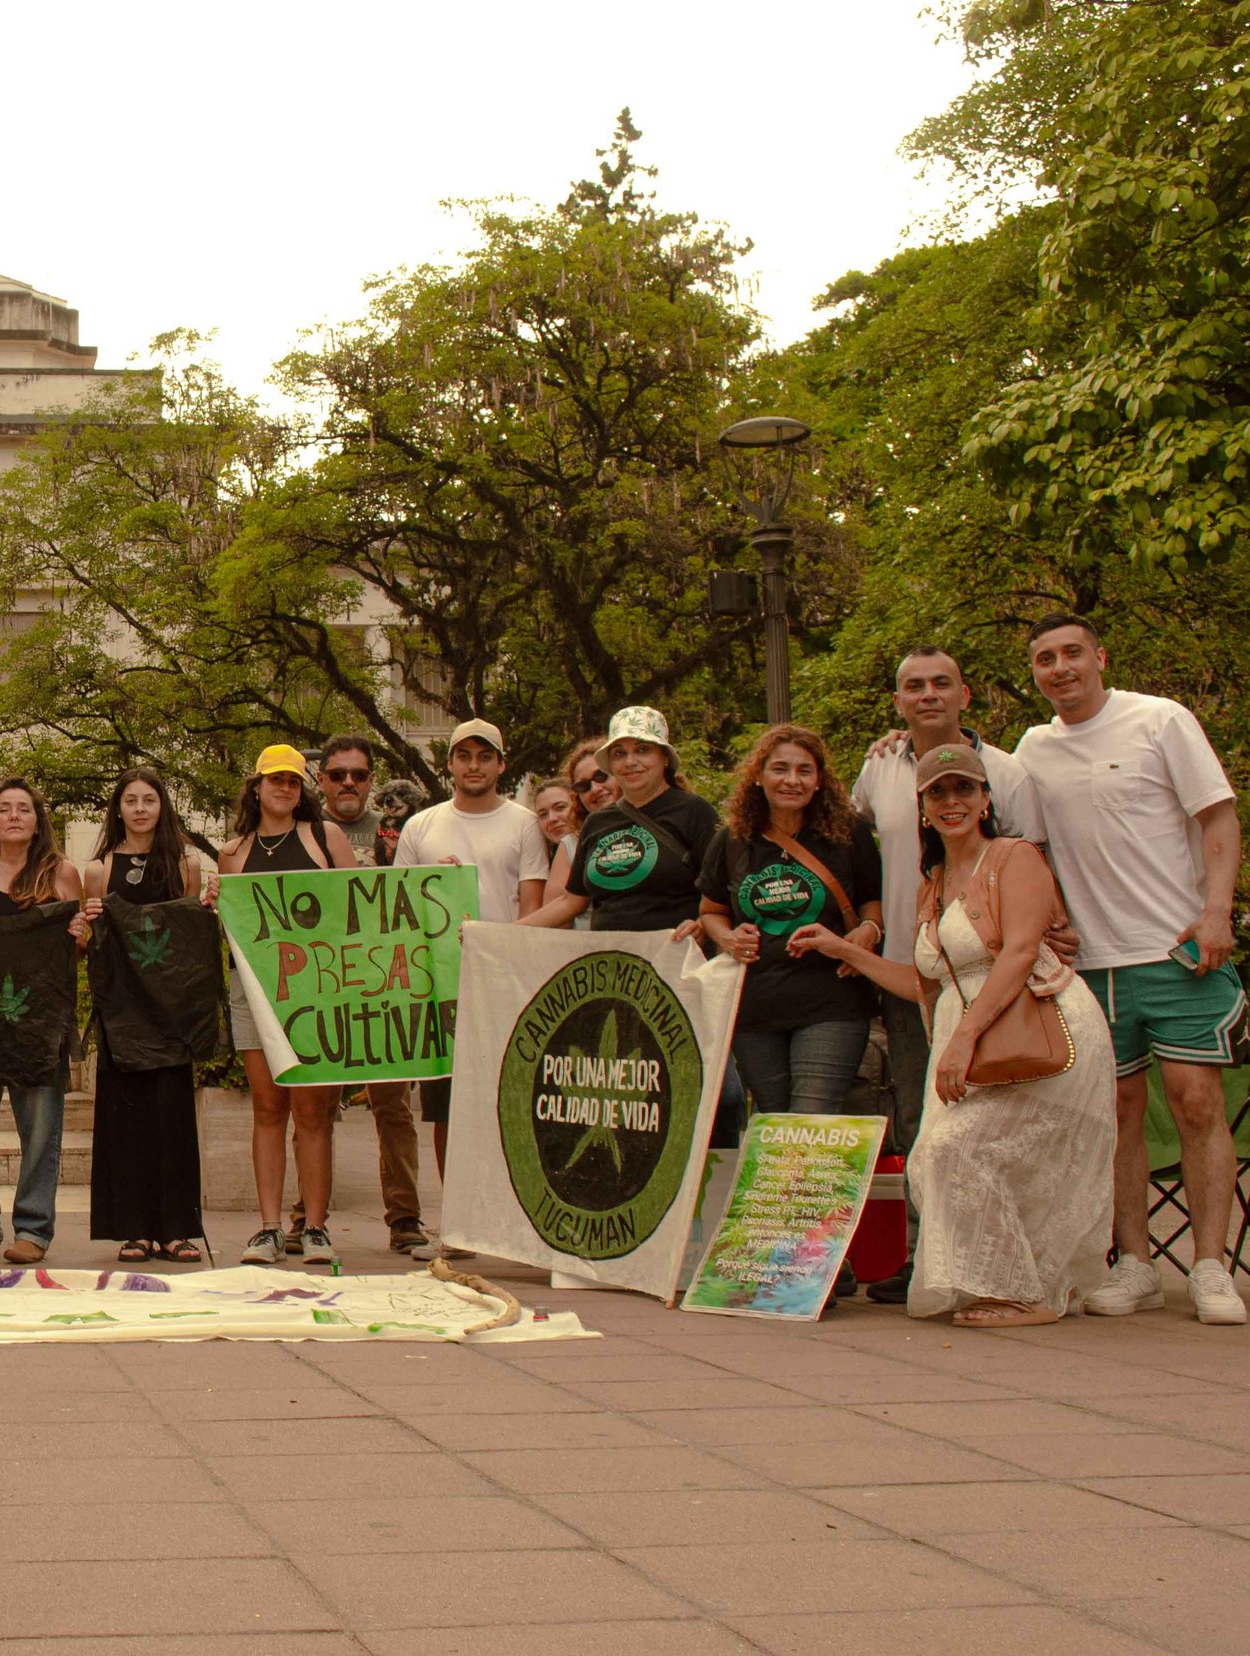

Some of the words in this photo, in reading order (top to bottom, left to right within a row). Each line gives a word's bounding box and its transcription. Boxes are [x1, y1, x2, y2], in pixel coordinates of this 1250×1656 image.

[346, 869, 451, 939] MÁS
[266, 941, 435, 1002] PRESAS
[515, 959, 608, 1064] CANNABIS
[612, 960, 688, 1065] MEDICINAL
[543, 1054, 573, 1088] POR
[575, 1056, 607, 1089] UNA
[606, 1058, 661, 1093] MEJOR
[536, 1094, 600, 1128] CALIDAD
[602, 1099, 619, 1130] DE
[621, 1100, 660, 1133] VIDA
[759, 1126, 860, 1147] CANNABIS
[534, 1186, 637, 1251] TUCUMAN
